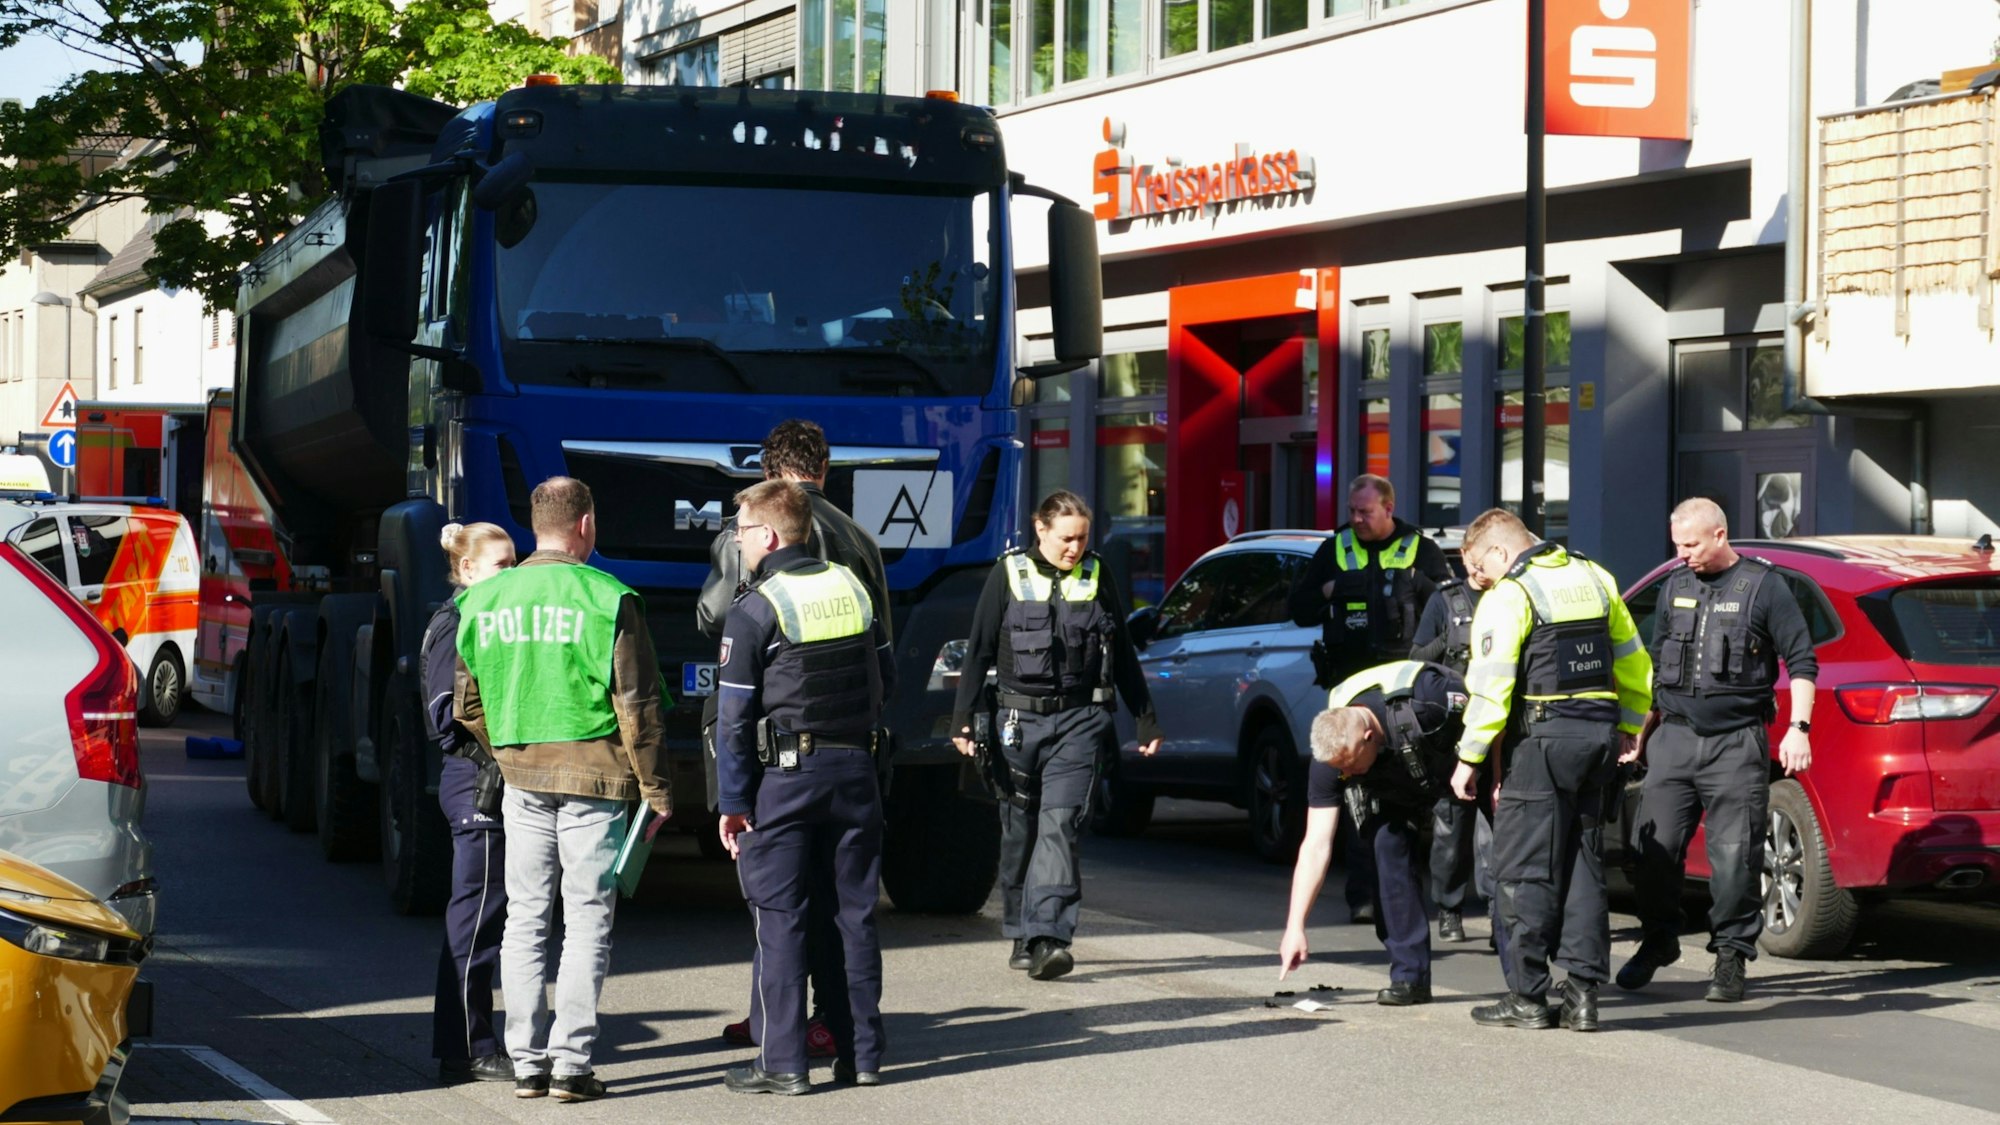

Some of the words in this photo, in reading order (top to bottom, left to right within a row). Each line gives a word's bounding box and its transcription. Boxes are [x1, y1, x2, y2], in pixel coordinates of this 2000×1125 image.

[1131, 143, 1299, 219] Kreissparkasse
[878, 484, 928, 536] A
[177, 555, 190, 573] 112
[1551, 585, 1598, 606] POLIZEI
[802, 596, 855, 622] POLIZEI
[1713, 602, 1739, 613] POLIZEI
[477, 605, 584, 648] POLIZEI
[1576, 642, 1594, 656] VU
[1568, 659, 1602, 673] Team
